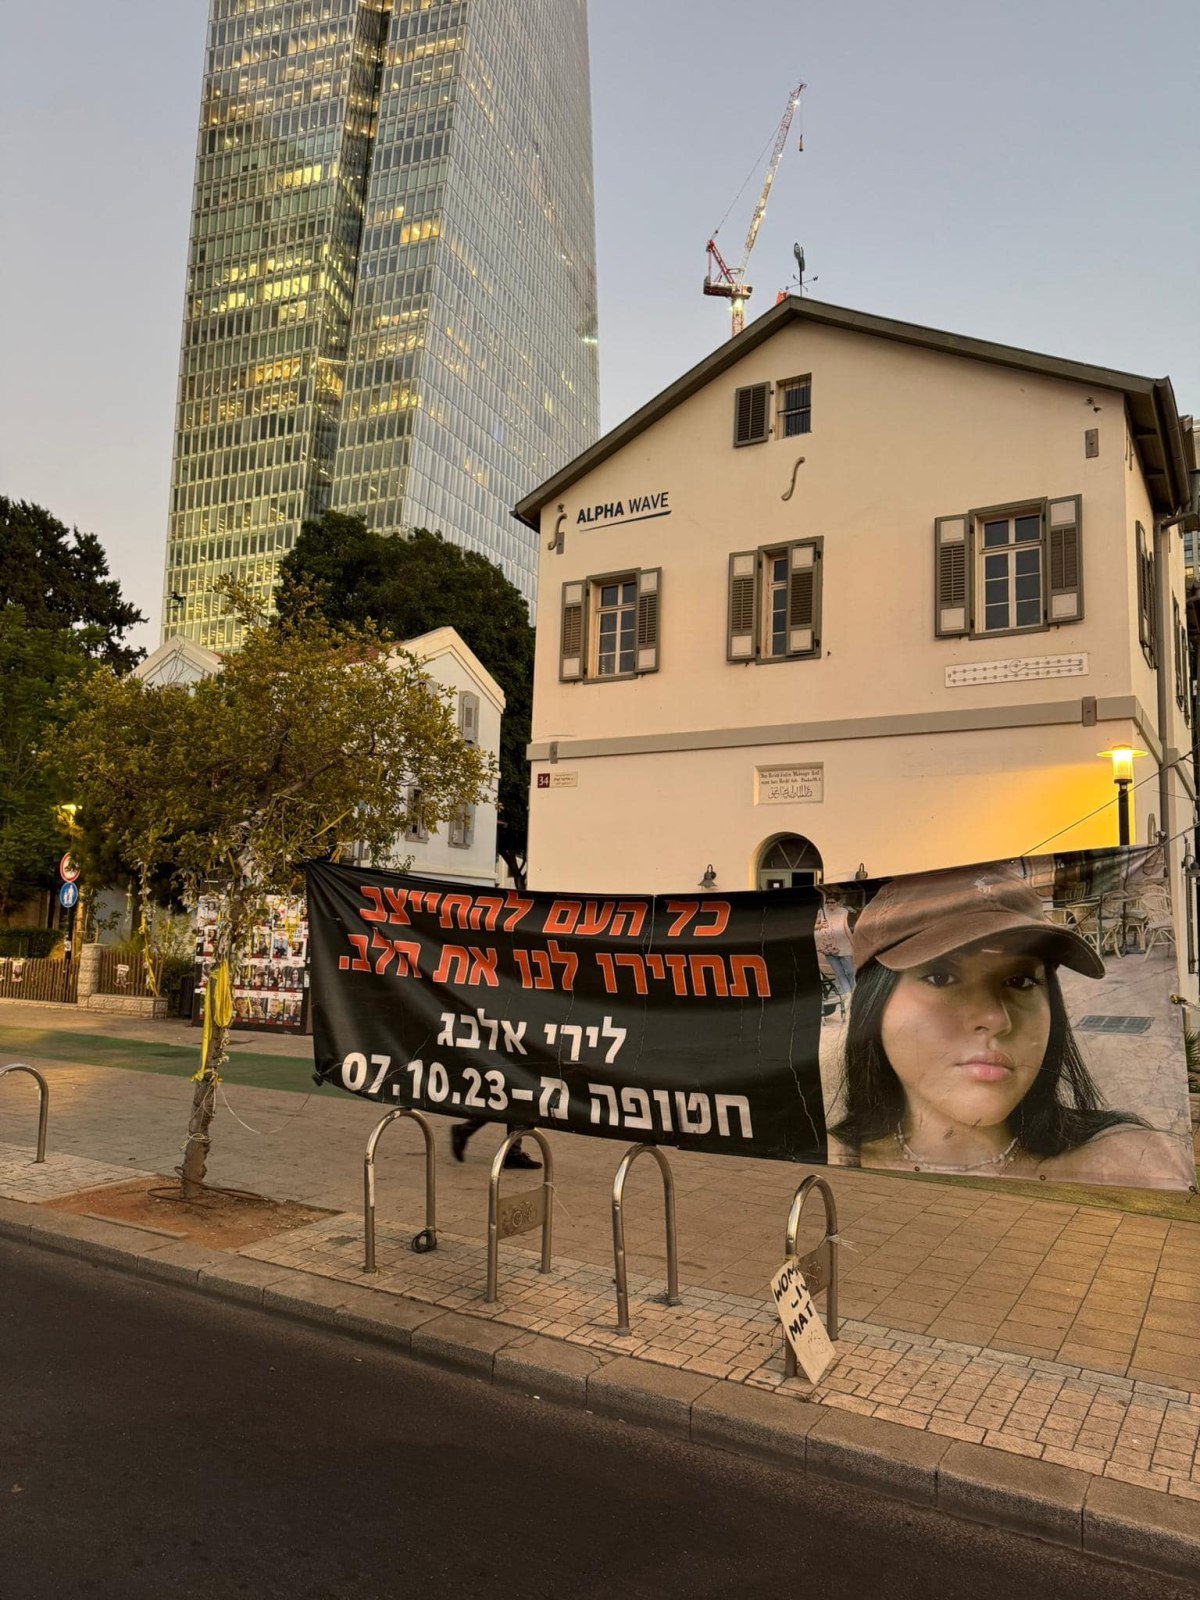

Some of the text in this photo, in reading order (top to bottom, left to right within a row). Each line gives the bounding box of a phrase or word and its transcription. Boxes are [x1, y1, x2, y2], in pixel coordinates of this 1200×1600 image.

[576, 491, 669, 524] ALPHA WAVE
[360, 885, 732, 936] כל העם להתייצב
[338, 927, 772, 997] תחזירו לנו את הלב.
[436, 1007, 628, 1064] לירי אלבג
[587, 1082, 753, 1139] חטופה
[788, 1300, 814, 1342] MAT
